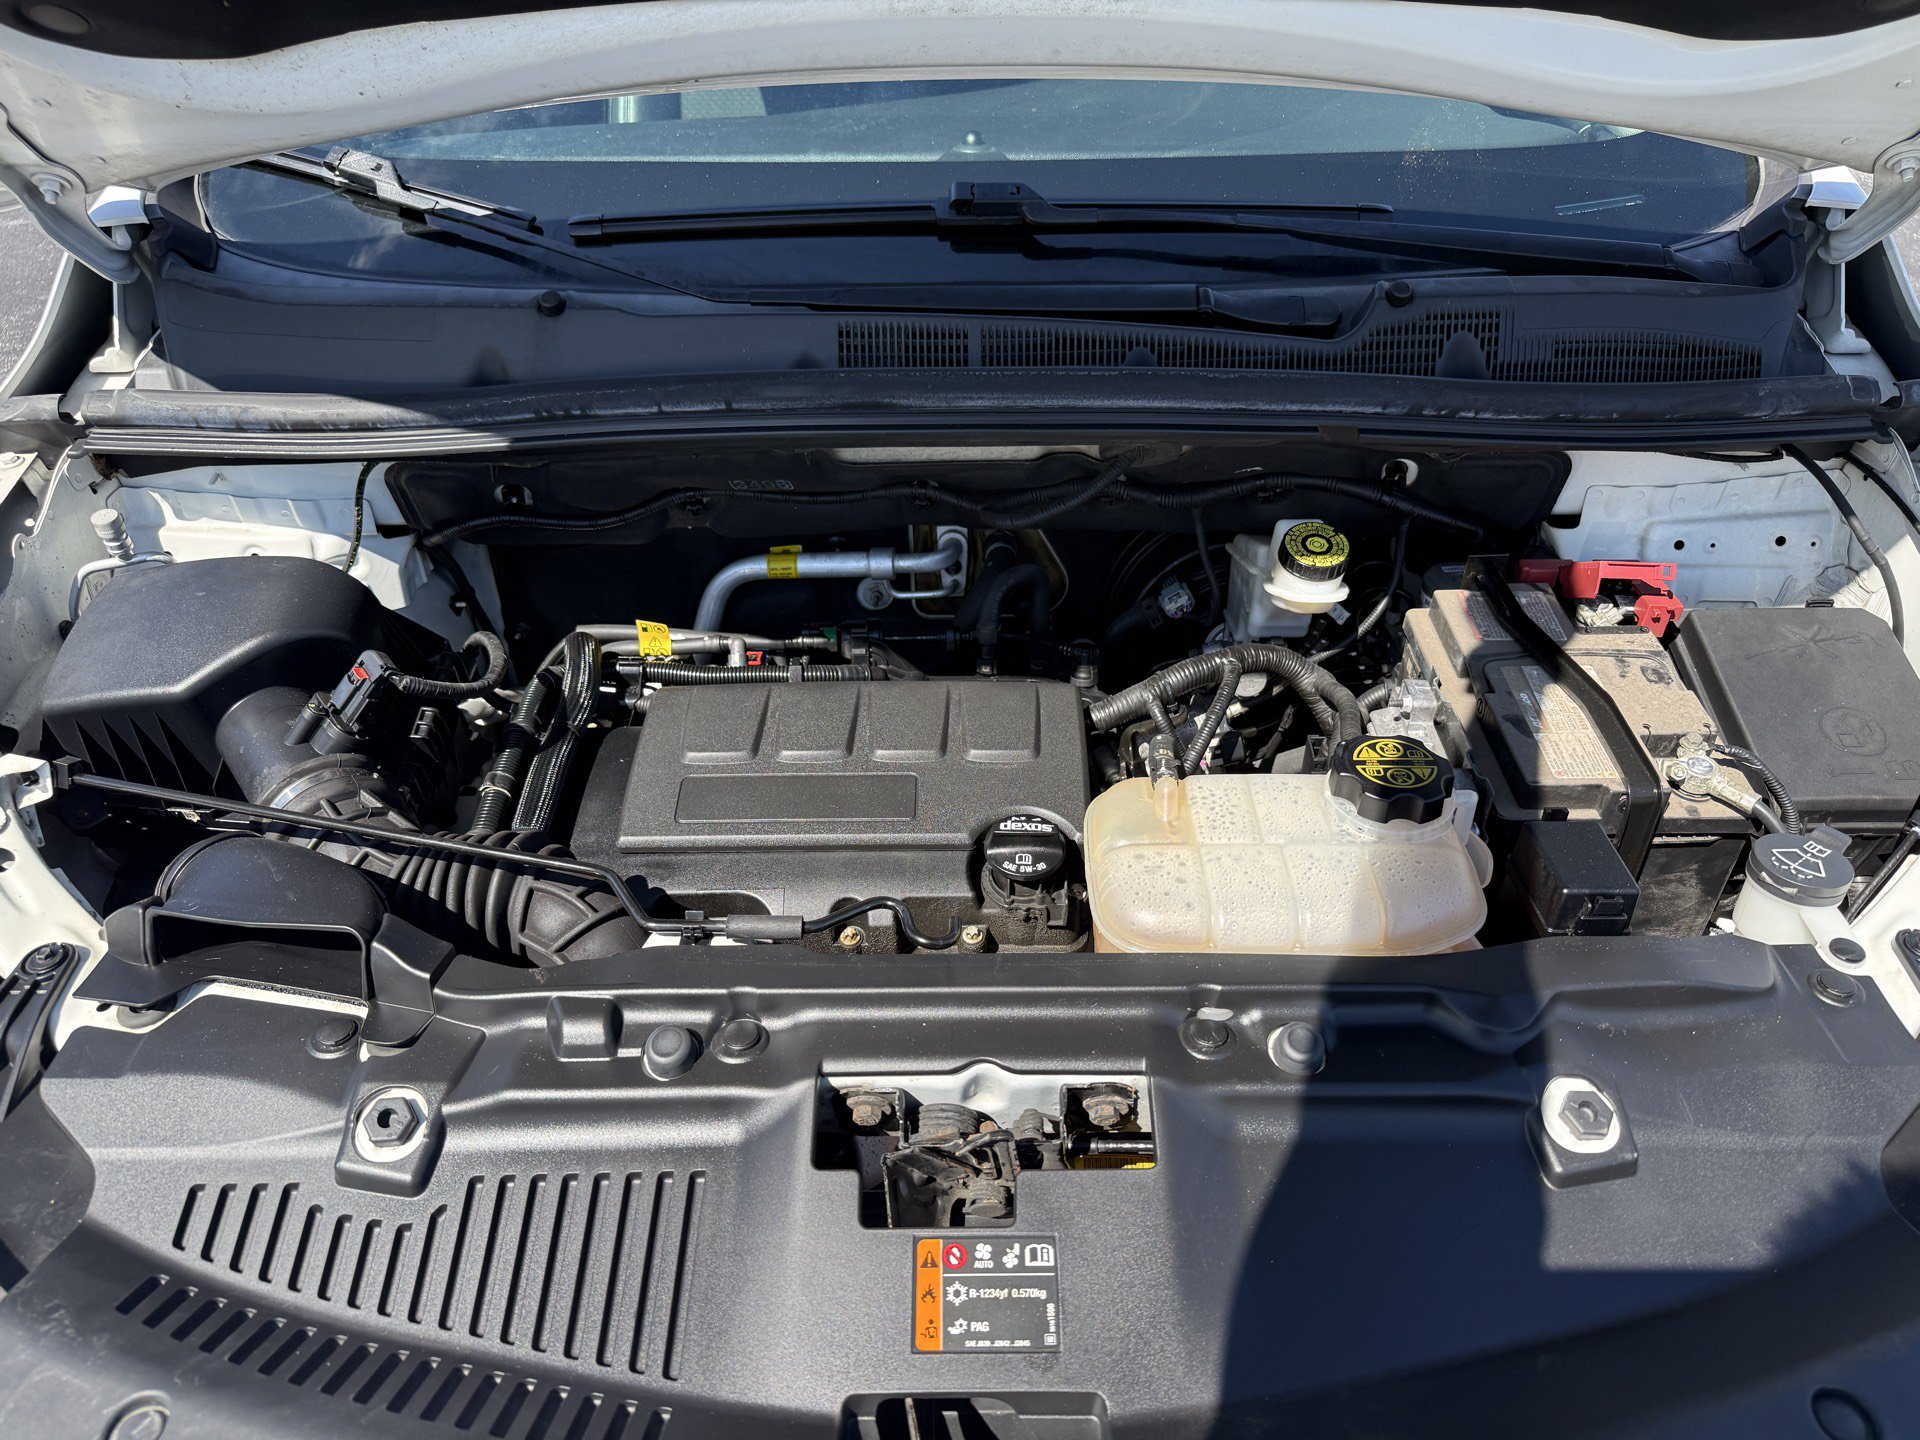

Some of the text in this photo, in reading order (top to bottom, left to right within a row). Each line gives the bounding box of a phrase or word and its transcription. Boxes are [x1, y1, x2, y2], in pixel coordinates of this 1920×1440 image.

[999, 820, 1054, 832] dexos
[1002, 861, 1047, 873] SAE 5W-30
[974, 1260, 994, 1269] AUTO
[969, 1288, 1047, 1300] R-1234yf 0.570kg
[970, 1321, 990, 1332] PAG
